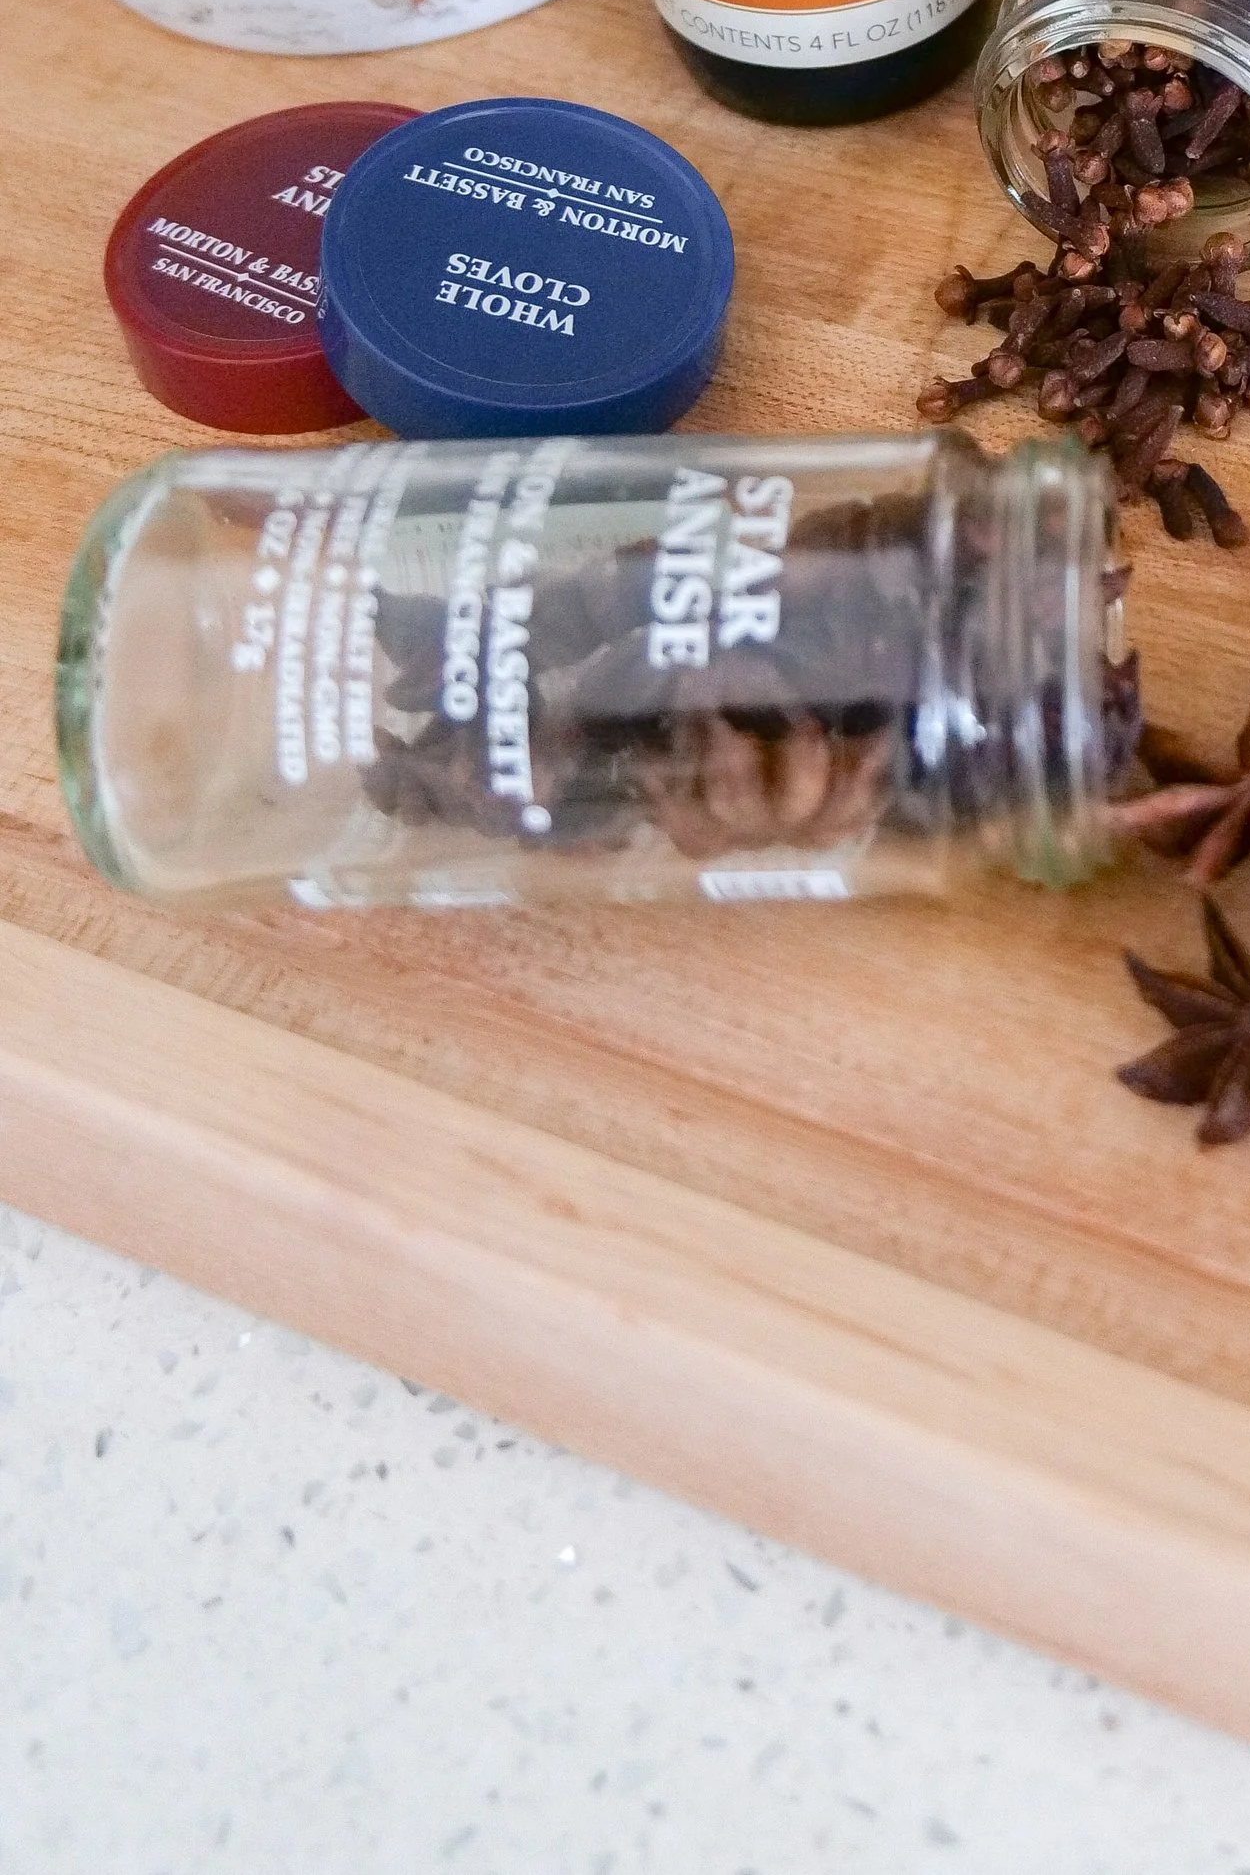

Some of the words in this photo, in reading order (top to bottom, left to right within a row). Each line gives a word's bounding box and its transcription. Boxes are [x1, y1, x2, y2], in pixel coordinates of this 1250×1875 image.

[680, 9, 802, 53] CONTENTS
[809, 34, 823, 51] 4
[832, 31, 859, 50] FL
[866, 17, 900, 42] OZ
[403, 164, 527, 211] BASSETT
[463, 146, 603, 195] FRANCISCO
[604, 184, 656, 209] SAN
[271, 185, 333, 217] ANI
[532, 197, 556, 217] &
[147, 217, 253, 266] MORTON
[248, 257, 271, 274] &
[559, 206, 689, 254] MORTON
[152, 257, 197, 282] SAN
[192, 272, 306, 325] FRANCISCO
[446, 252, 591, 307] CLOVES
[435, 280, 575, 337] WHOLE
[499, 538, 539, 583] &
[648, 467, 728, 671] ANISE
[718, 475, 795, 648] STAR
[441, 498, 500, 723] FRANCISCO
[485, 585, 535, 802] BASSETT
